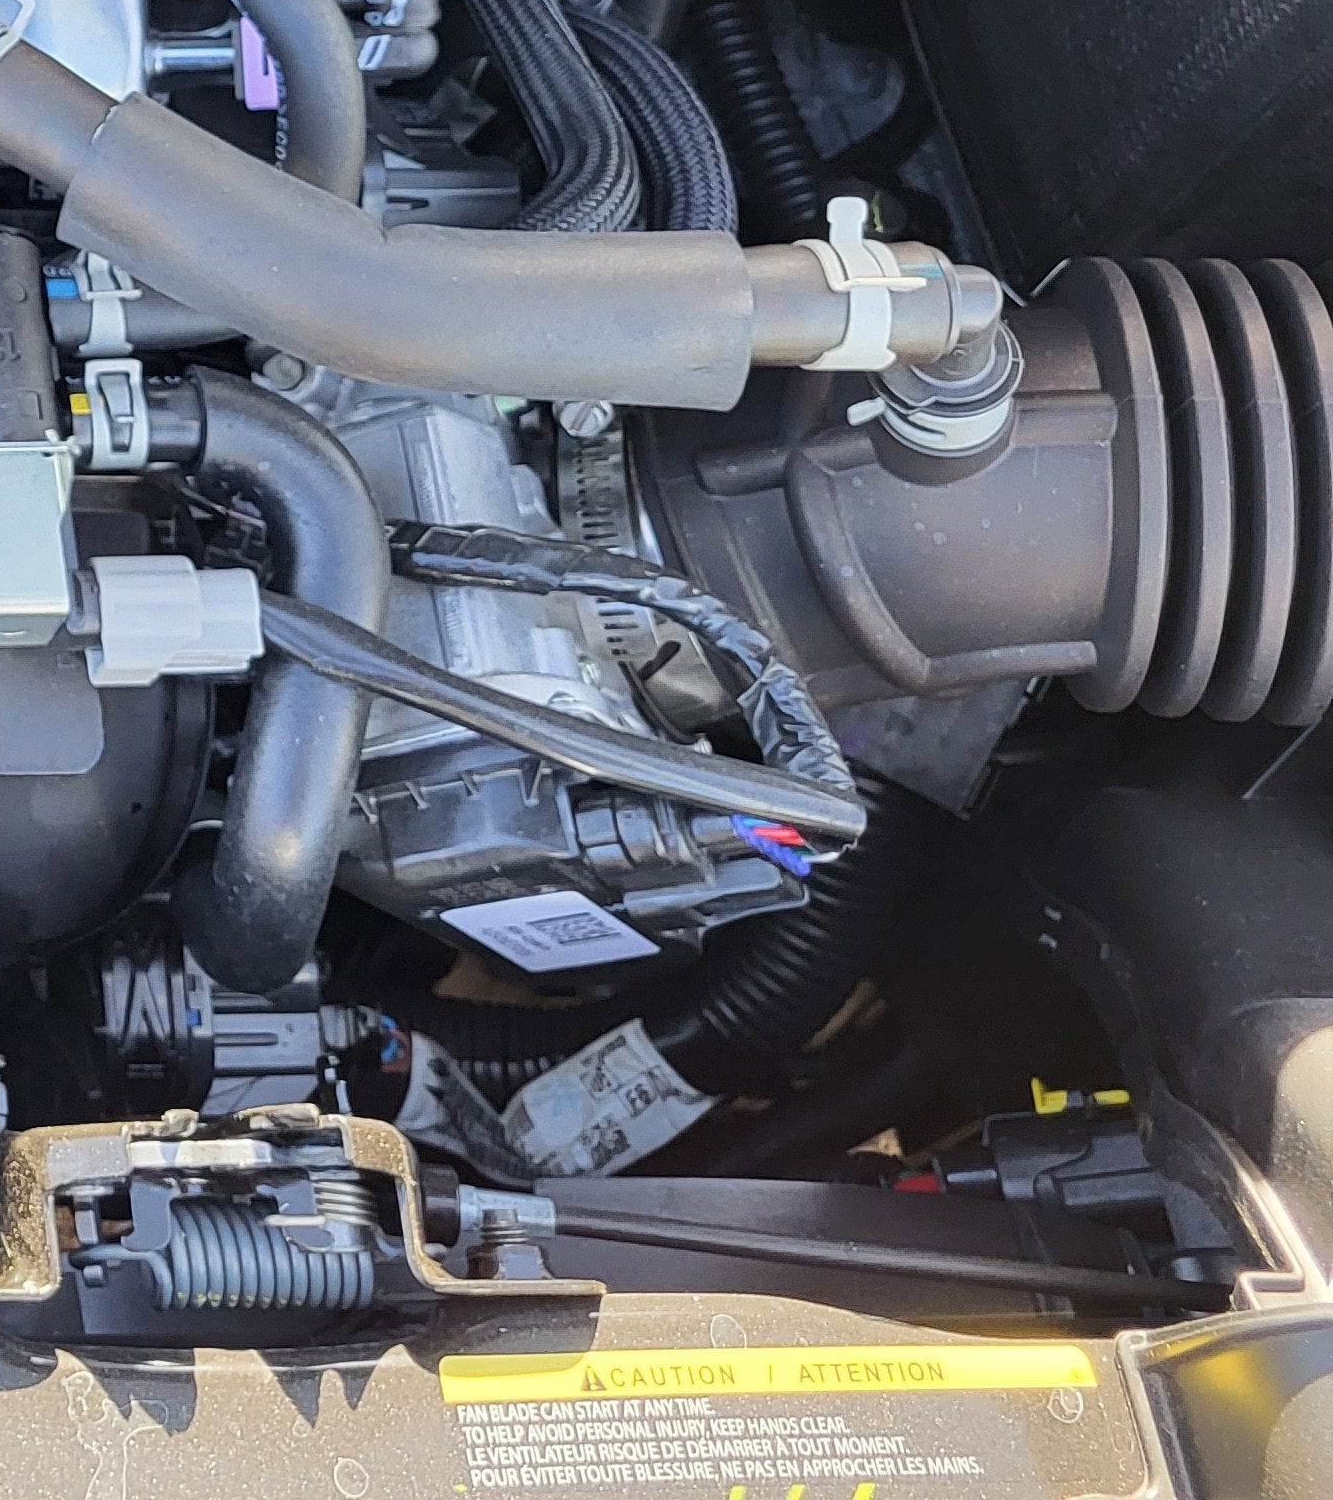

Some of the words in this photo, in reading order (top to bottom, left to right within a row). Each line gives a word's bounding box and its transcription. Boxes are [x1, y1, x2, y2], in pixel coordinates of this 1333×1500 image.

[610, 1364, 736, 1388] CAUTION
[799, 1361, 945, 1384] ATTENTION
[457, 1404, 488, 1424] FAN
[490, 1402, 540, 1422] BLADE
[541, 1401, 574, 1420] CAN
[575, 1400, 619, 1420] START
[623, 1399, 641, 1418] AT
[644, 1399, 675, 1417] ANY
[676, 1397, 716, 1416] TIME.
[462, 1426, 485, 1445] TO
[487, 1424, 524, 1444] HELP
[527, 1422, 574, 1442] AVOID
[576, 1419, 655, 1440] PERSONAL
[655, 1419, 710, 1438] INJURY,
[710, 1418, 745, 1436] KEEP
[747, 1417, 799, 1435] HANDS
[800, 1416, 850, 1434] CLEAR.
[465, 1448, 484, 1466] LE
[485, 1443, 598, 1466] VENTILATEUR
[598, 1443, 660, 1463] RISQUE
[661, 1441, 686, 1459] DE
[687, 1436, 775, 1459] DÉMARRER
[778, 1435, 791, 1456] À
[790, 1437, 831, 1456] TOUT
[835, 1436, 910, 1455] MOMENT.
[470, 1468, 520, 1488] POUR
[521, 1463, 576, 1486] ÉVITER
[576, 1464, 634, 1484] TOUTE
[635, 1461, 720, 1482] BLESSURE,
[720, 1461, 744, 1479] NE
[746, 1460, 776, 1478] PAS
[776, 1459, 799, 1478] EN
[803, 1457, 897, 1477] APPROCHER
[898, 1456, 926, 1475] LES
[927, 1455, 984, 1475] MAINS.
